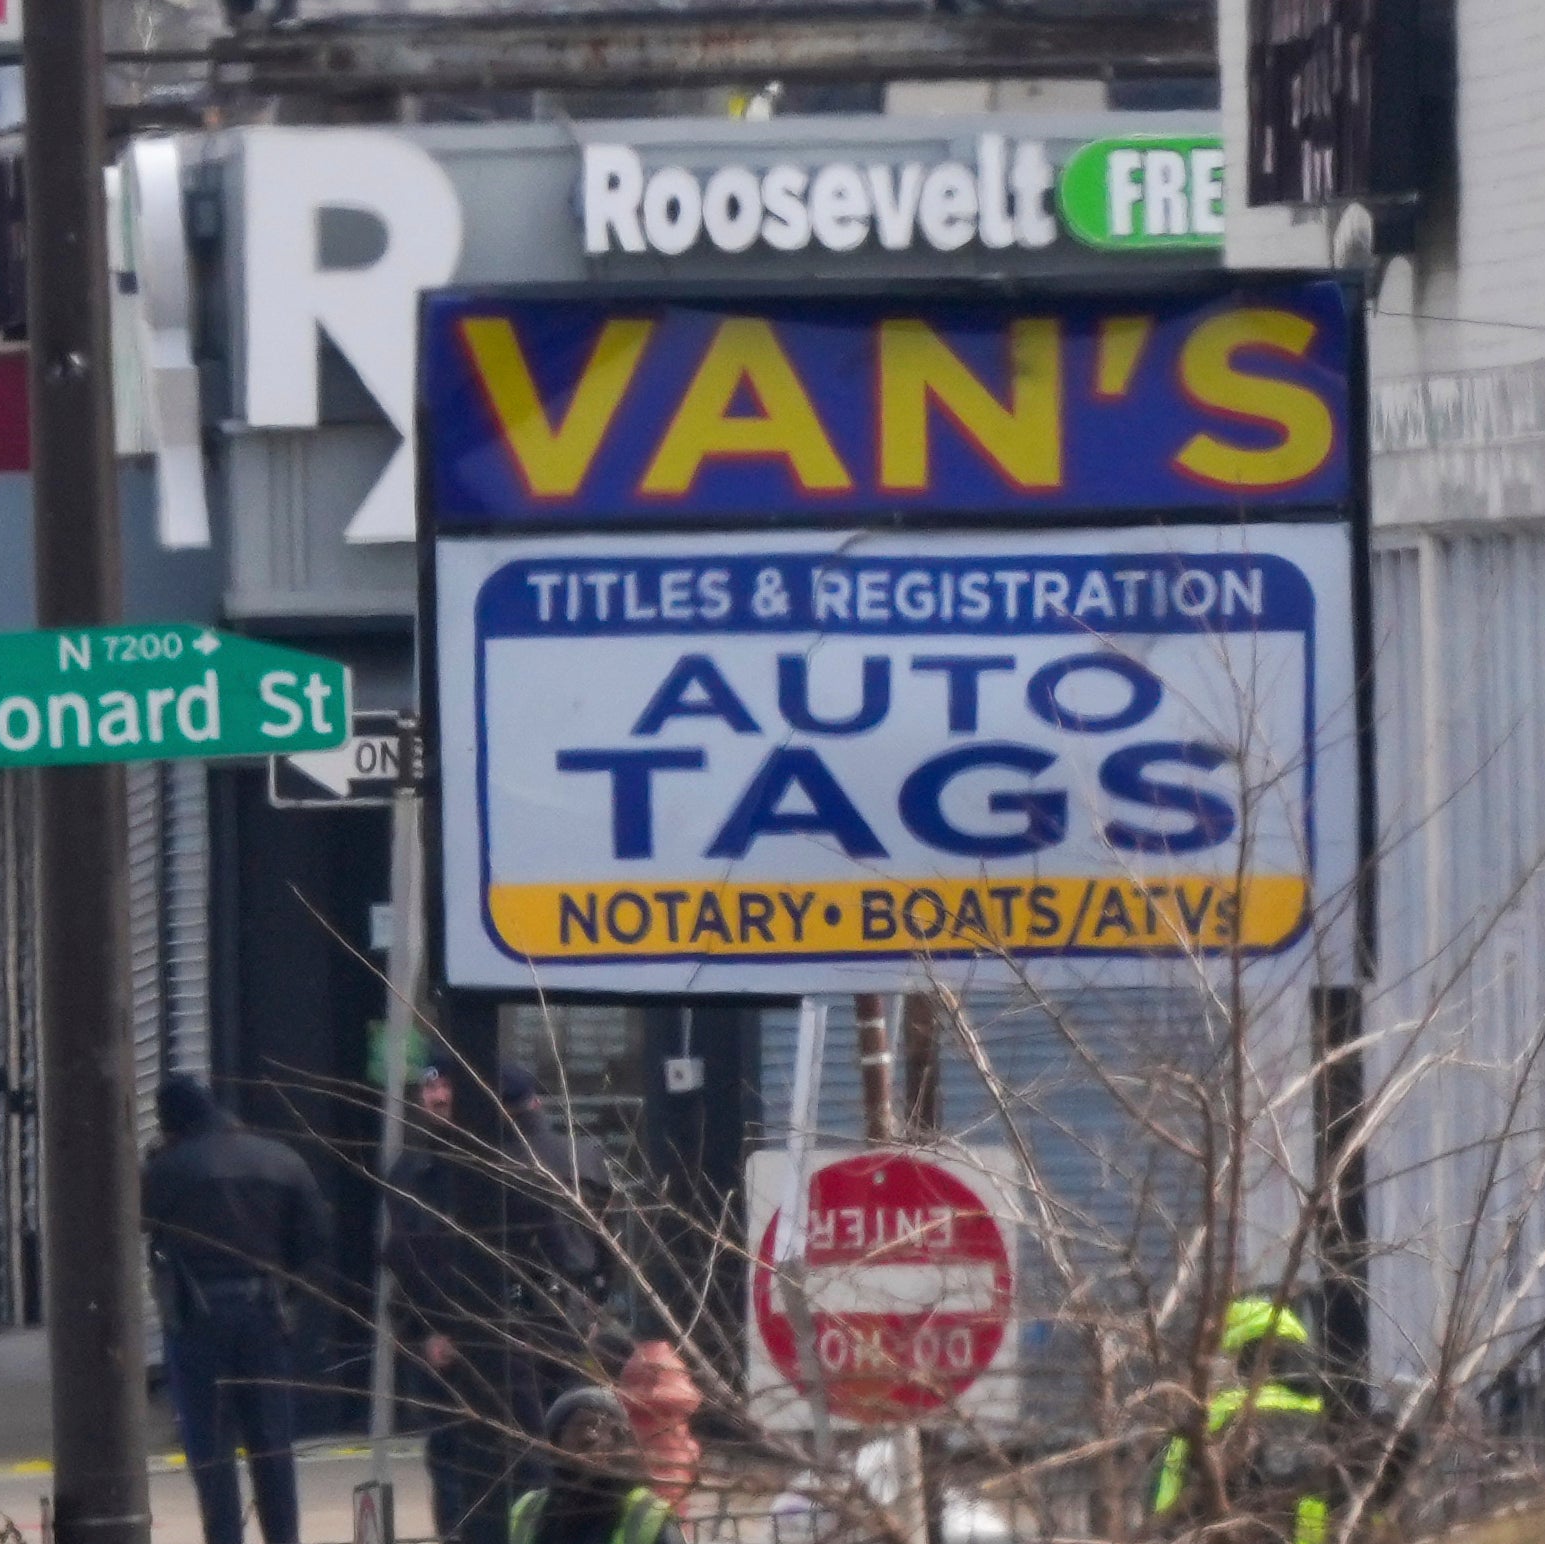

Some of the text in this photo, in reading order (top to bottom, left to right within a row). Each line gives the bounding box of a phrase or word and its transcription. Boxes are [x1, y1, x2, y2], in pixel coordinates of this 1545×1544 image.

[583, 133, 1057, 256] Roosevelt
[460, 308, 1336, 497] VAN'S
[526, 569, 1264, 622] TITLES & REGISTRATION
[59, 634, 182, 670] N 7200
[259, 672, 333, 738] St
[629, 652, 1165, 737] AUTO
[554, 740, 1238, 861] TAGS
[558, 889, 812, 946] NOTARY
[808, 1206, 954, 1251] ENTER
